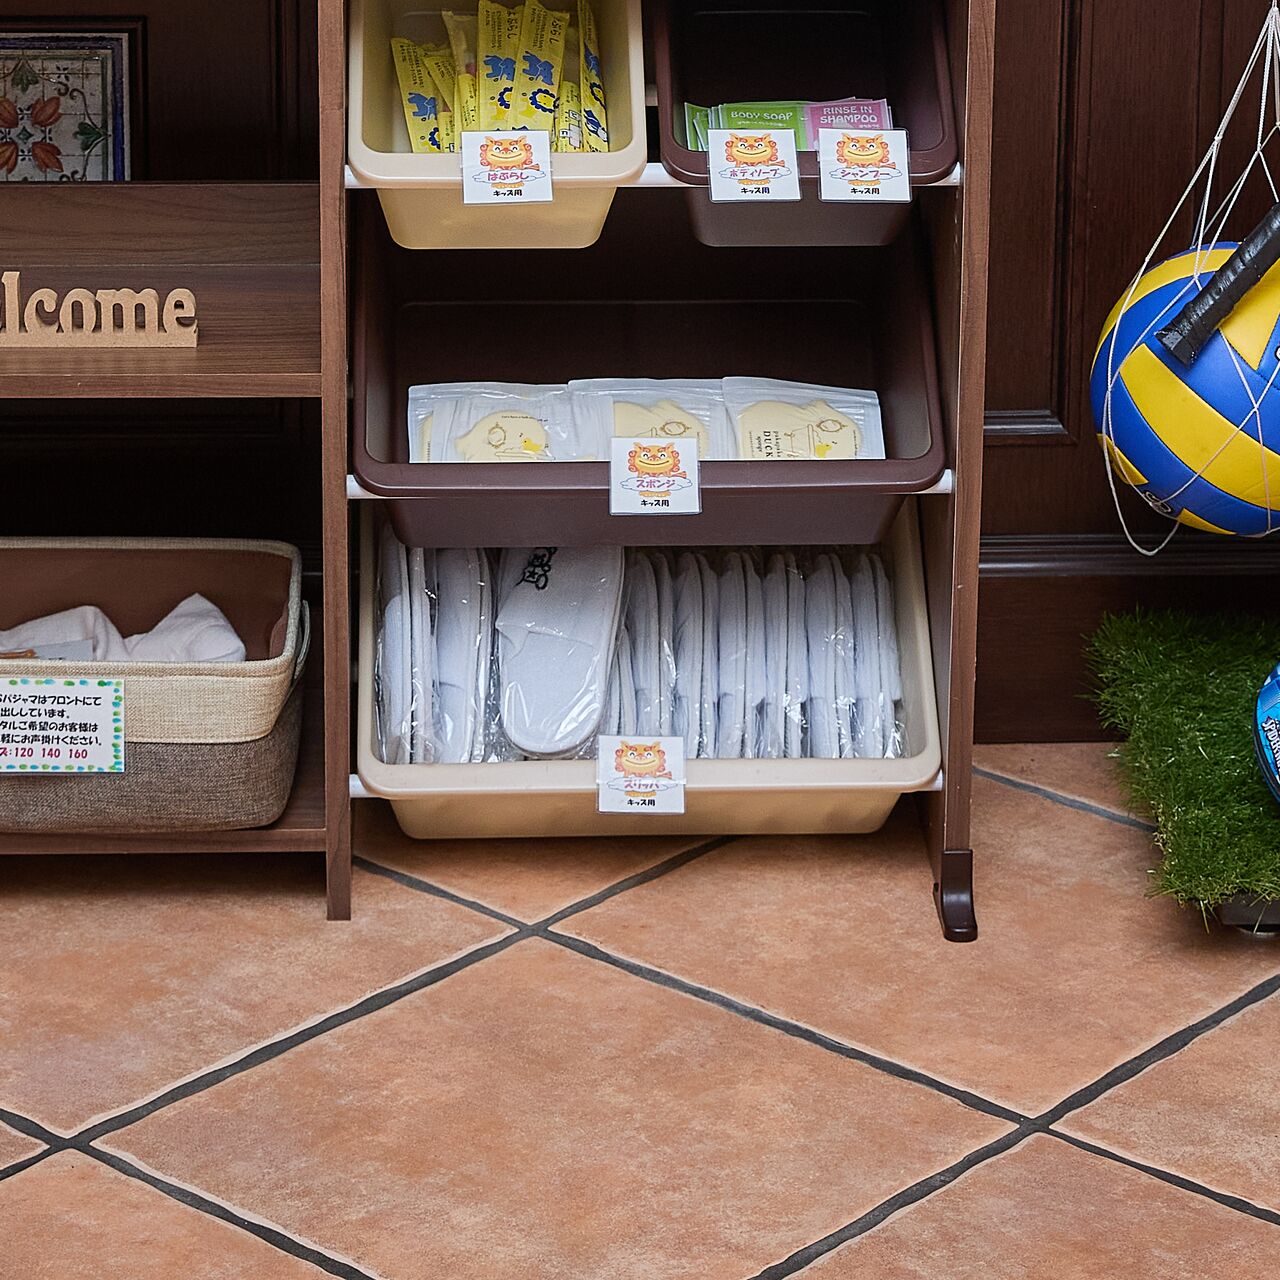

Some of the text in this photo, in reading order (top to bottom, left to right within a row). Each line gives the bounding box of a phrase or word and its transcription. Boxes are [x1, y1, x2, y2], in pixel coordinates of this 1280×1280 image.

[823, 106, 873, 114] RINSE IN
[731, 111, 793, 120] BODY SOAP
[820, 115, 878, 124] SHAMPOO
[487, 172, 530, 181] はぶらし
[730, 168, 780, 177] ボディソープ
[840, 169, 890, 178] シャンプー
[636, 479, 676, 488] スポンジ
[42, 747, 61, 759] 140
[69, 748, 88, 759] 160
